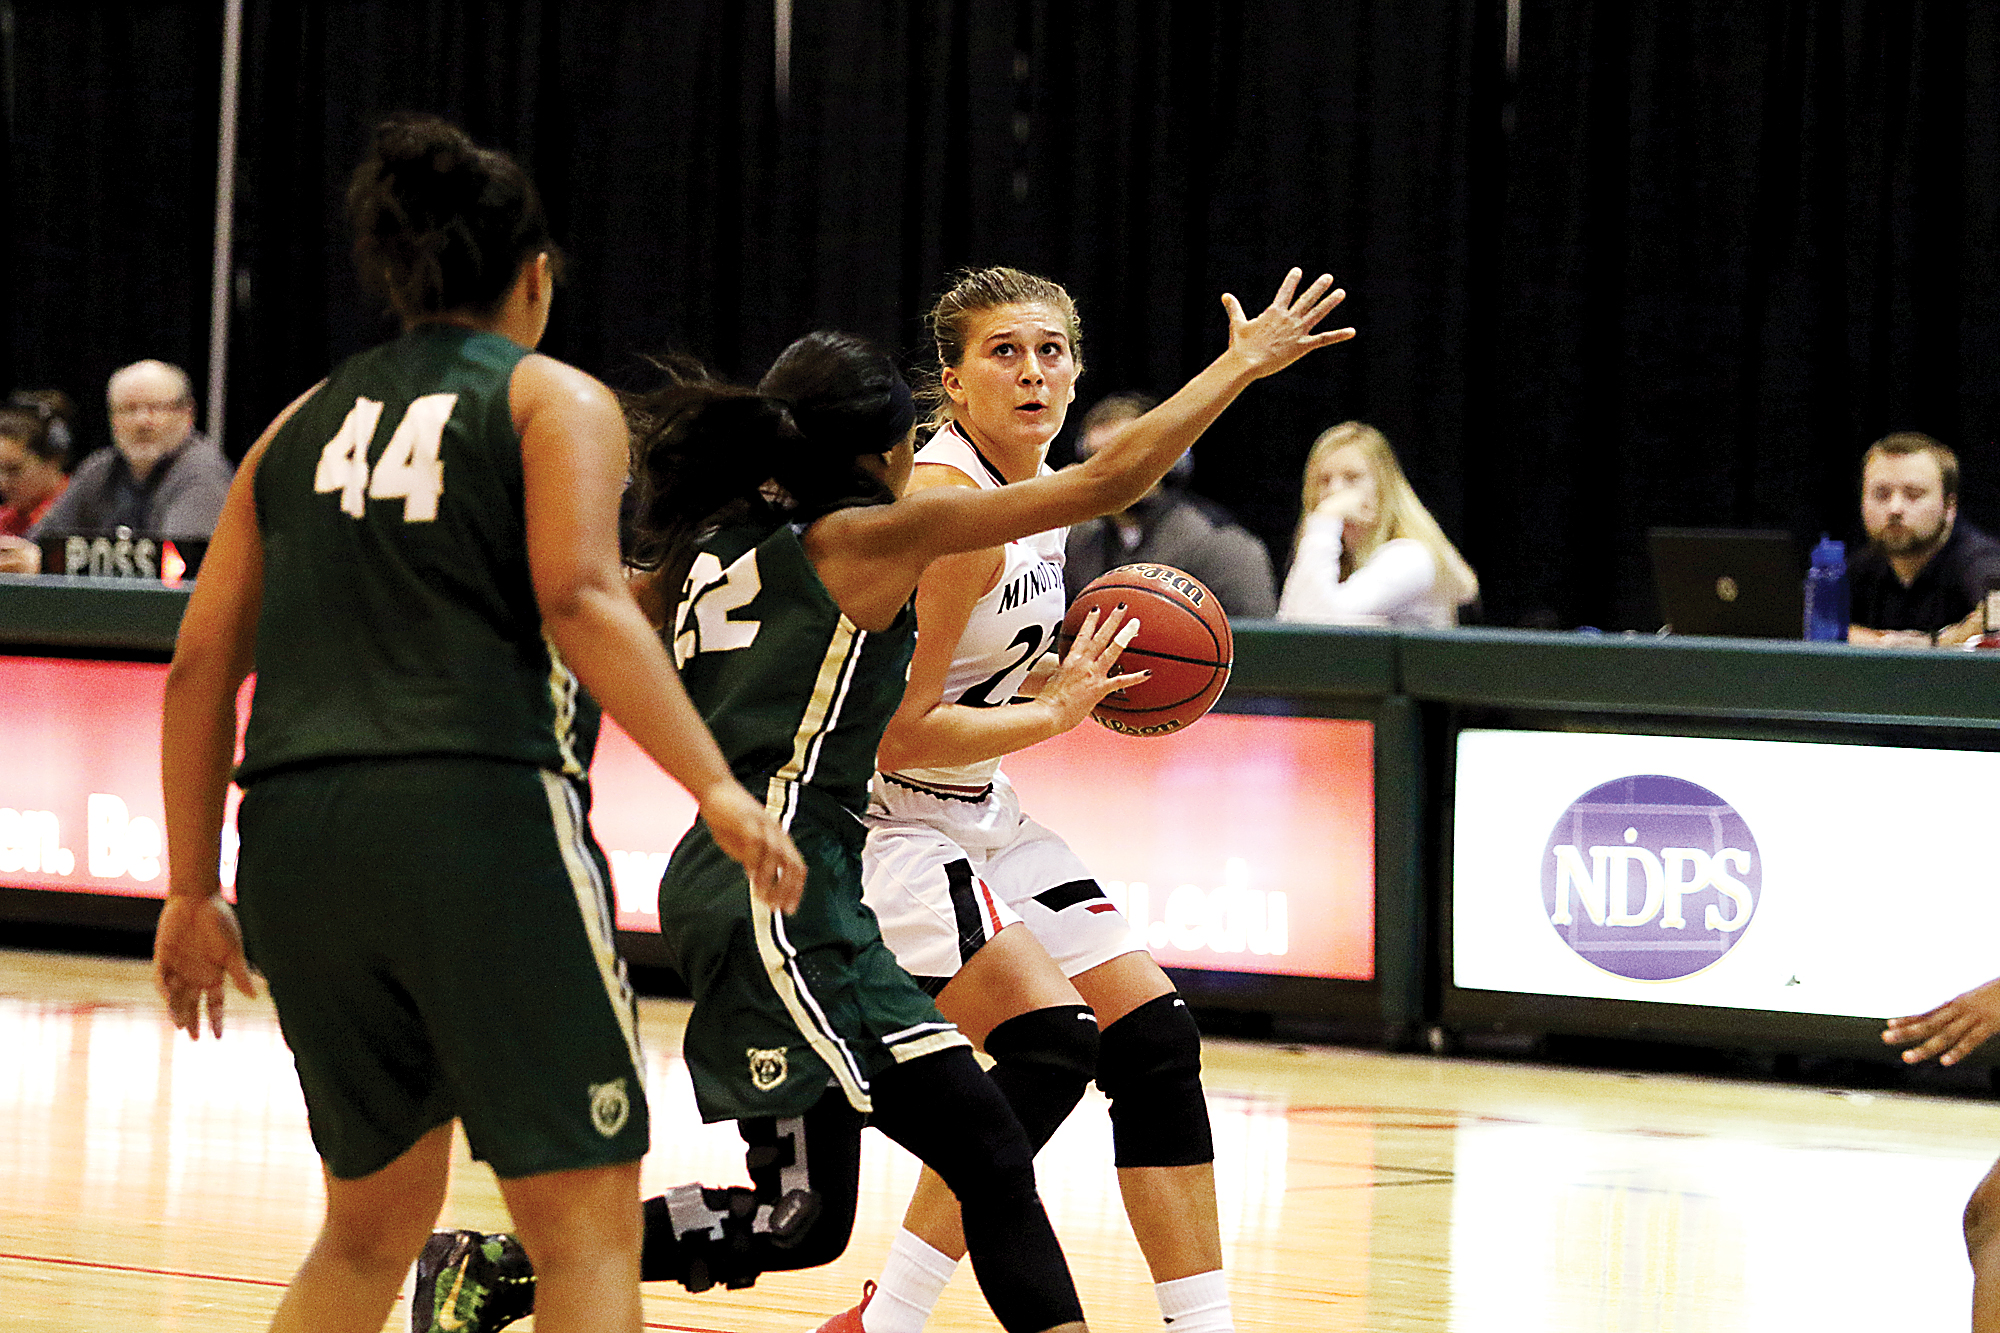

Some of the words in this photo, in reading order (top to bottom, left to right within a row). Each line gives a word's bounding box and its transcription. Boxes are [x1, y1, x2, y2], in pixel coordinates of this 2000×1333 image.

[314, 393, 459, 523] 44
[88, 792, 163, 882] Be
[1551, 844, 1754, 933] NDPS
